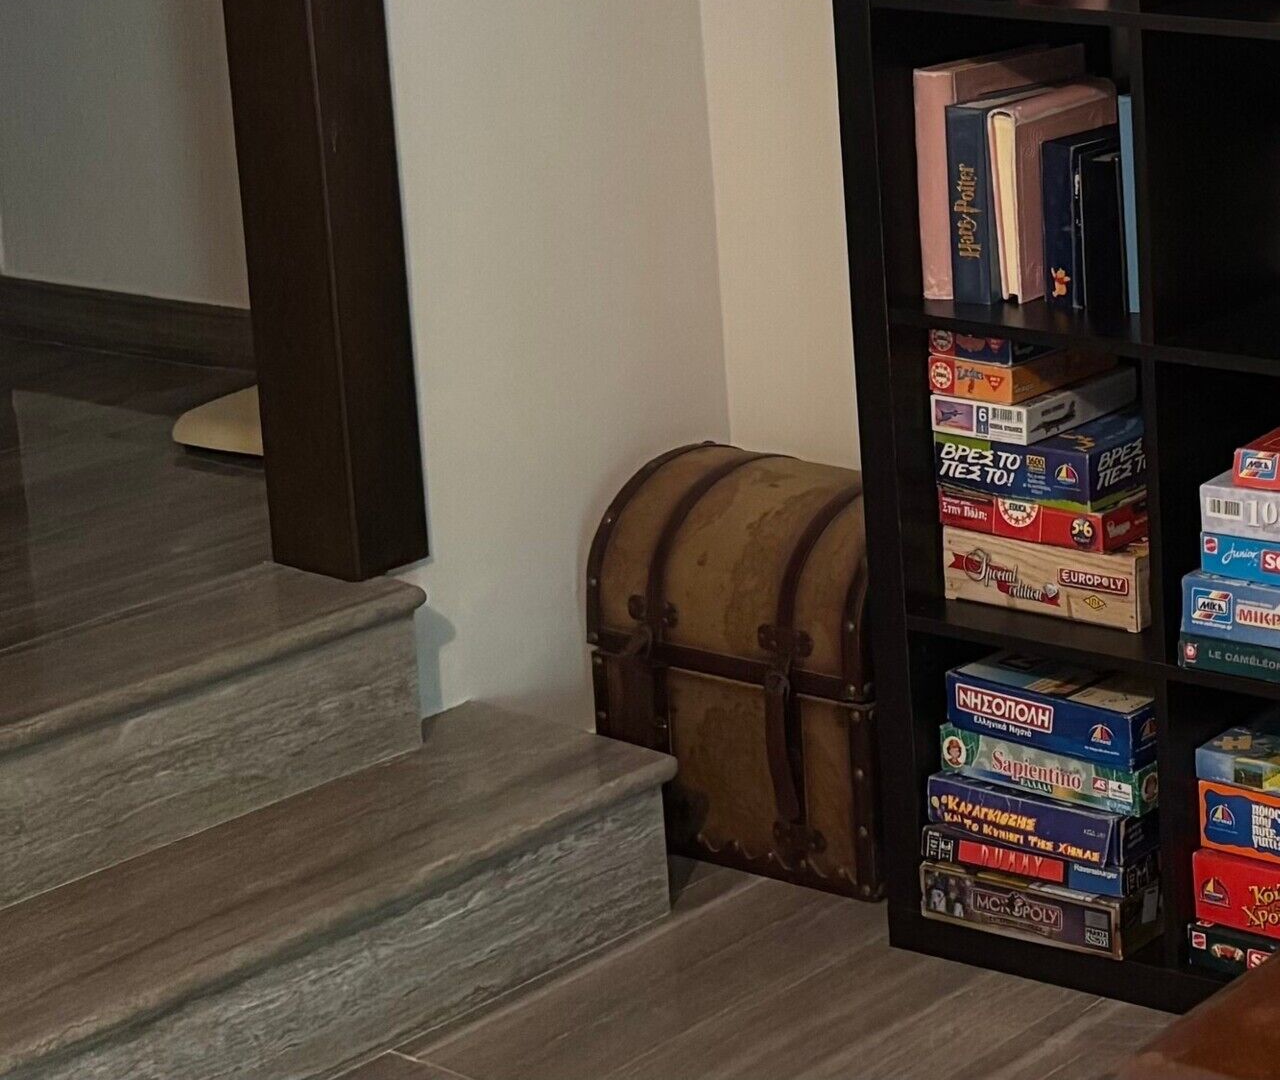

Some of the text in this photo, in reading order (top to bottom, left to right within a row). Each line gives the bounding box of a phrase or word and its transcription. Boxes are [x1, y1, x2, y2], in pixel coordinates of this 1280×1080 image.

[953, 163, 982, 259] Harry Potter
[978, 408, 987, 422] 6
[940, 442, 1020, 470] ΒΡΕΣ ΤΟ
[1097, 437, 1144, 472] ΒΡΕΣ
[939, 459, 1015, 487] ΠΕΣ ΤΟ!
[1096, 462, 1132, 491] ΠΕΣ
[1221, 543, 1259, 565] Junior
[1208, 649, 1221, 660] LE
[959, 689, 1050, 728] ΝΗΣΟΠΟΛΗ
[991, 750, 1082, 791] Sapientino
